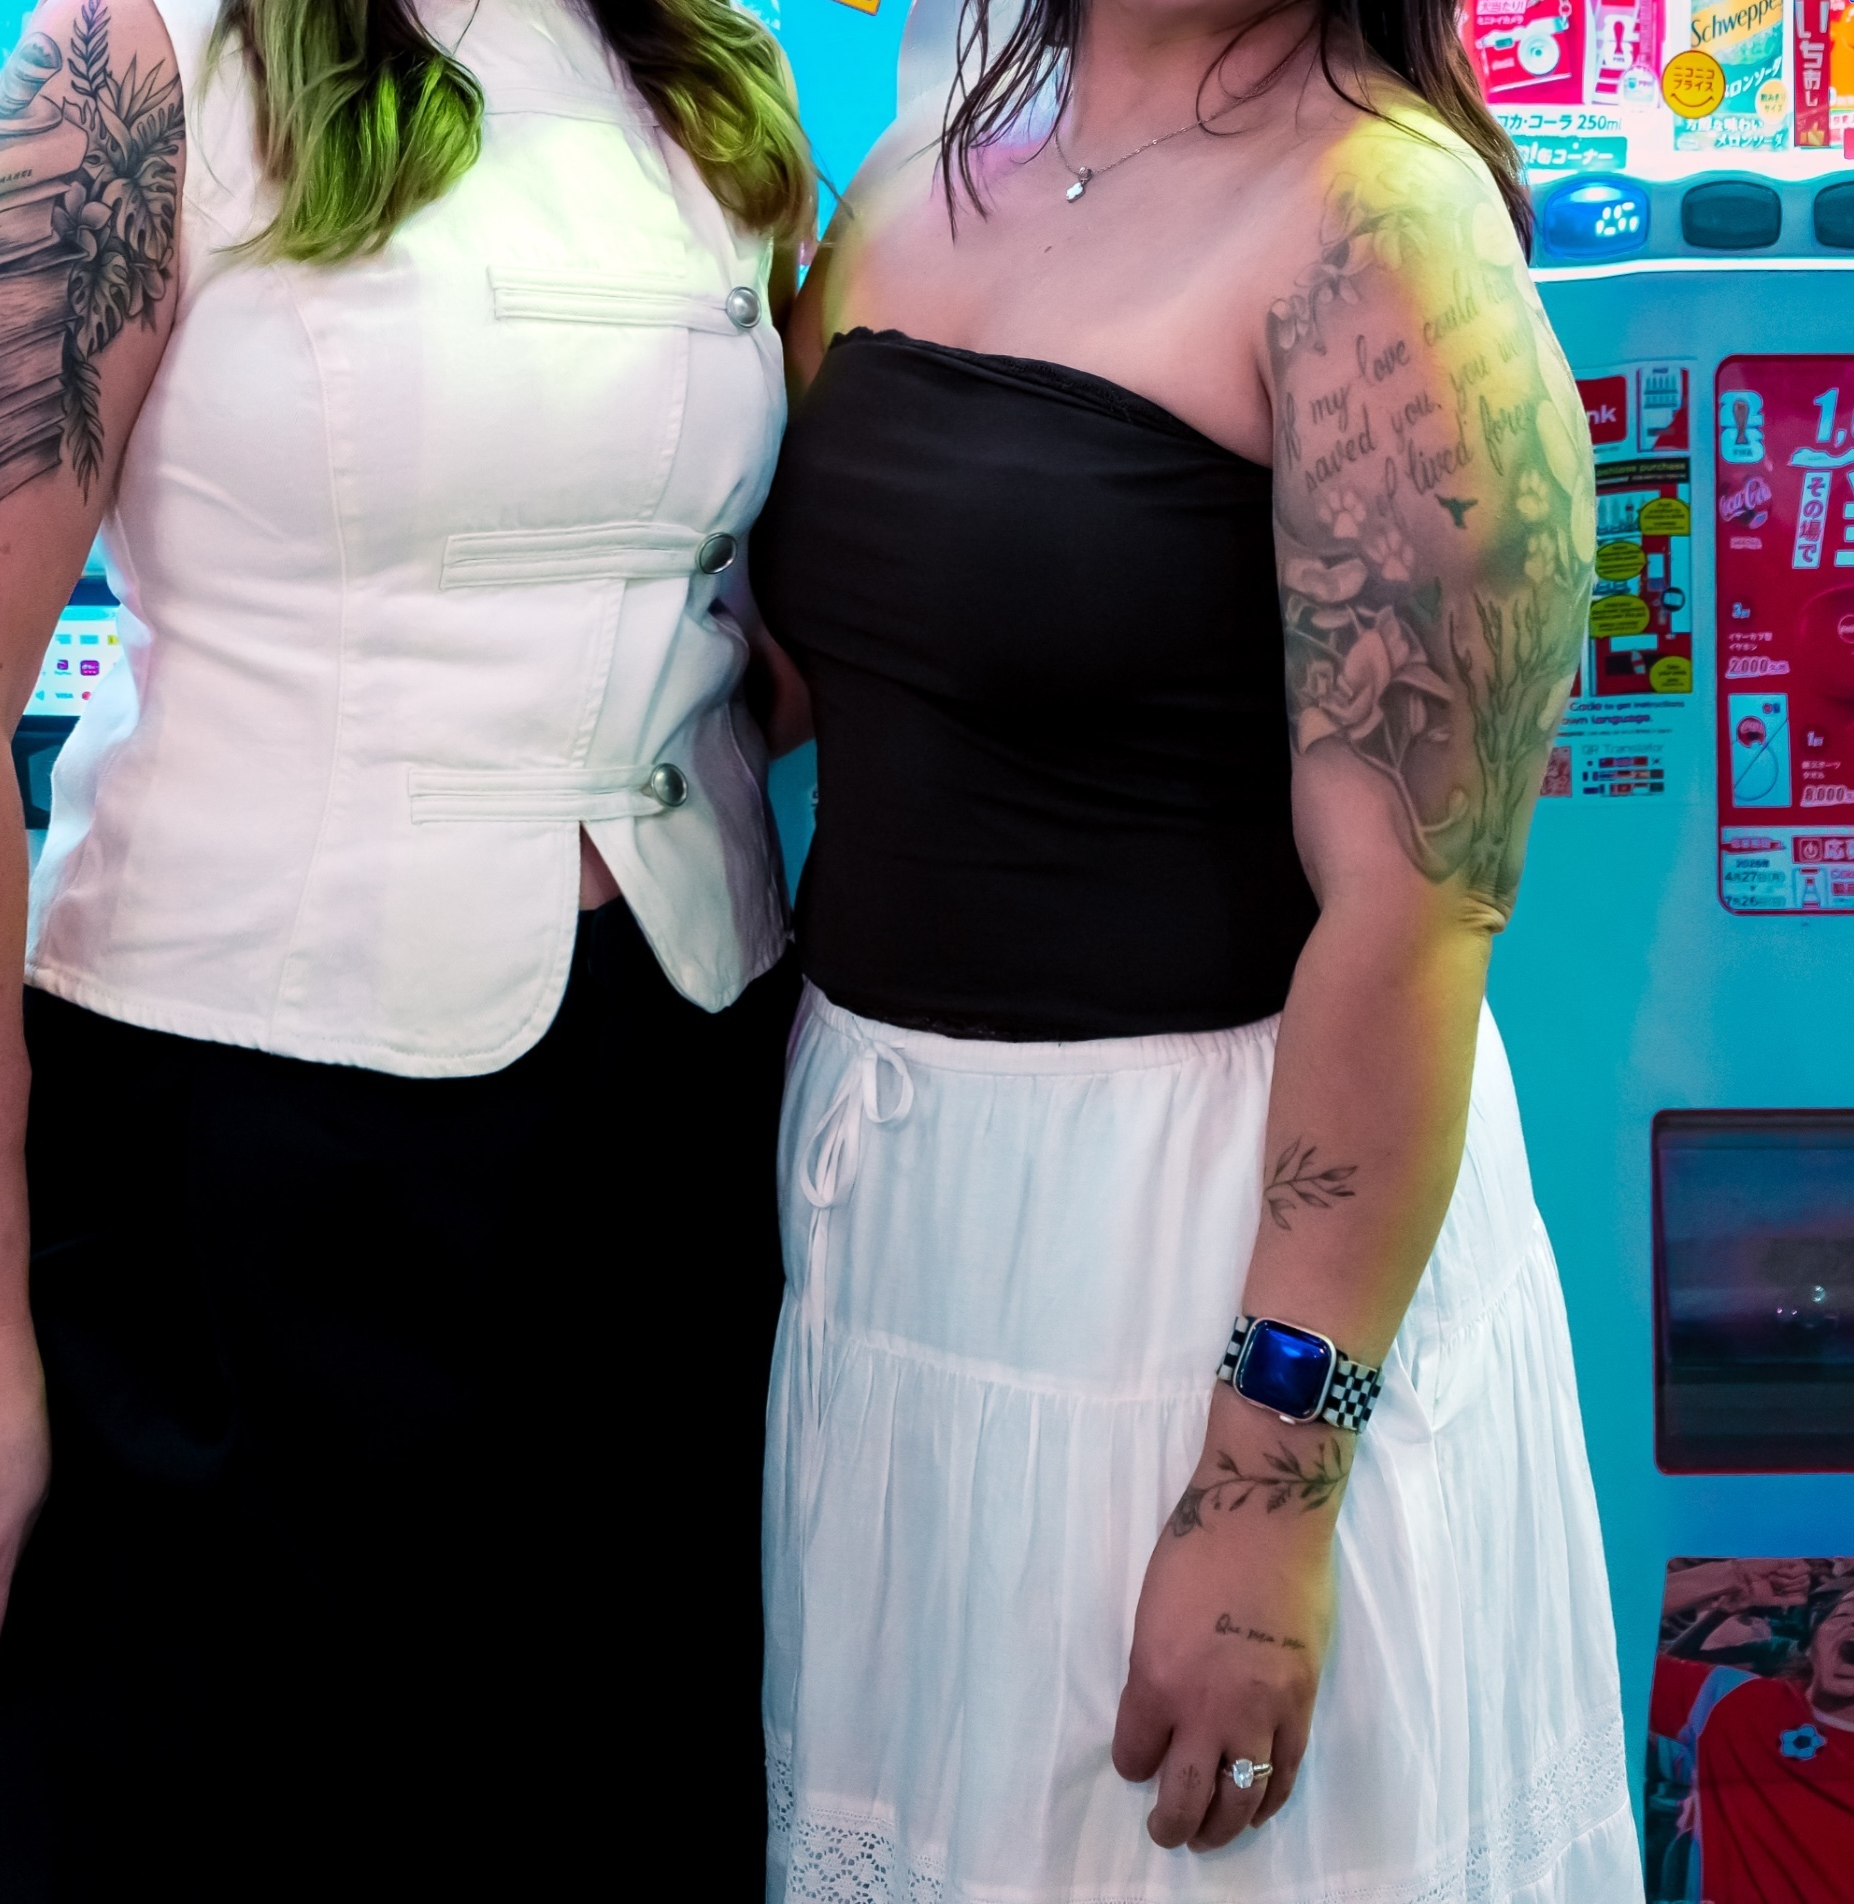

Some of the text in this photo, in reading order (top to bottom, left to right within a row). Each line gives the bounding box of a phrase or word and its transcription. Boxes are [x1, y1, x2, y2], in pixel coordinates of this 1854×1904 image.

[1355, 333, 1412, 387] love
[1301, 402, 1377, 494] saved
[1797, 475, 1826, 564] その場で
